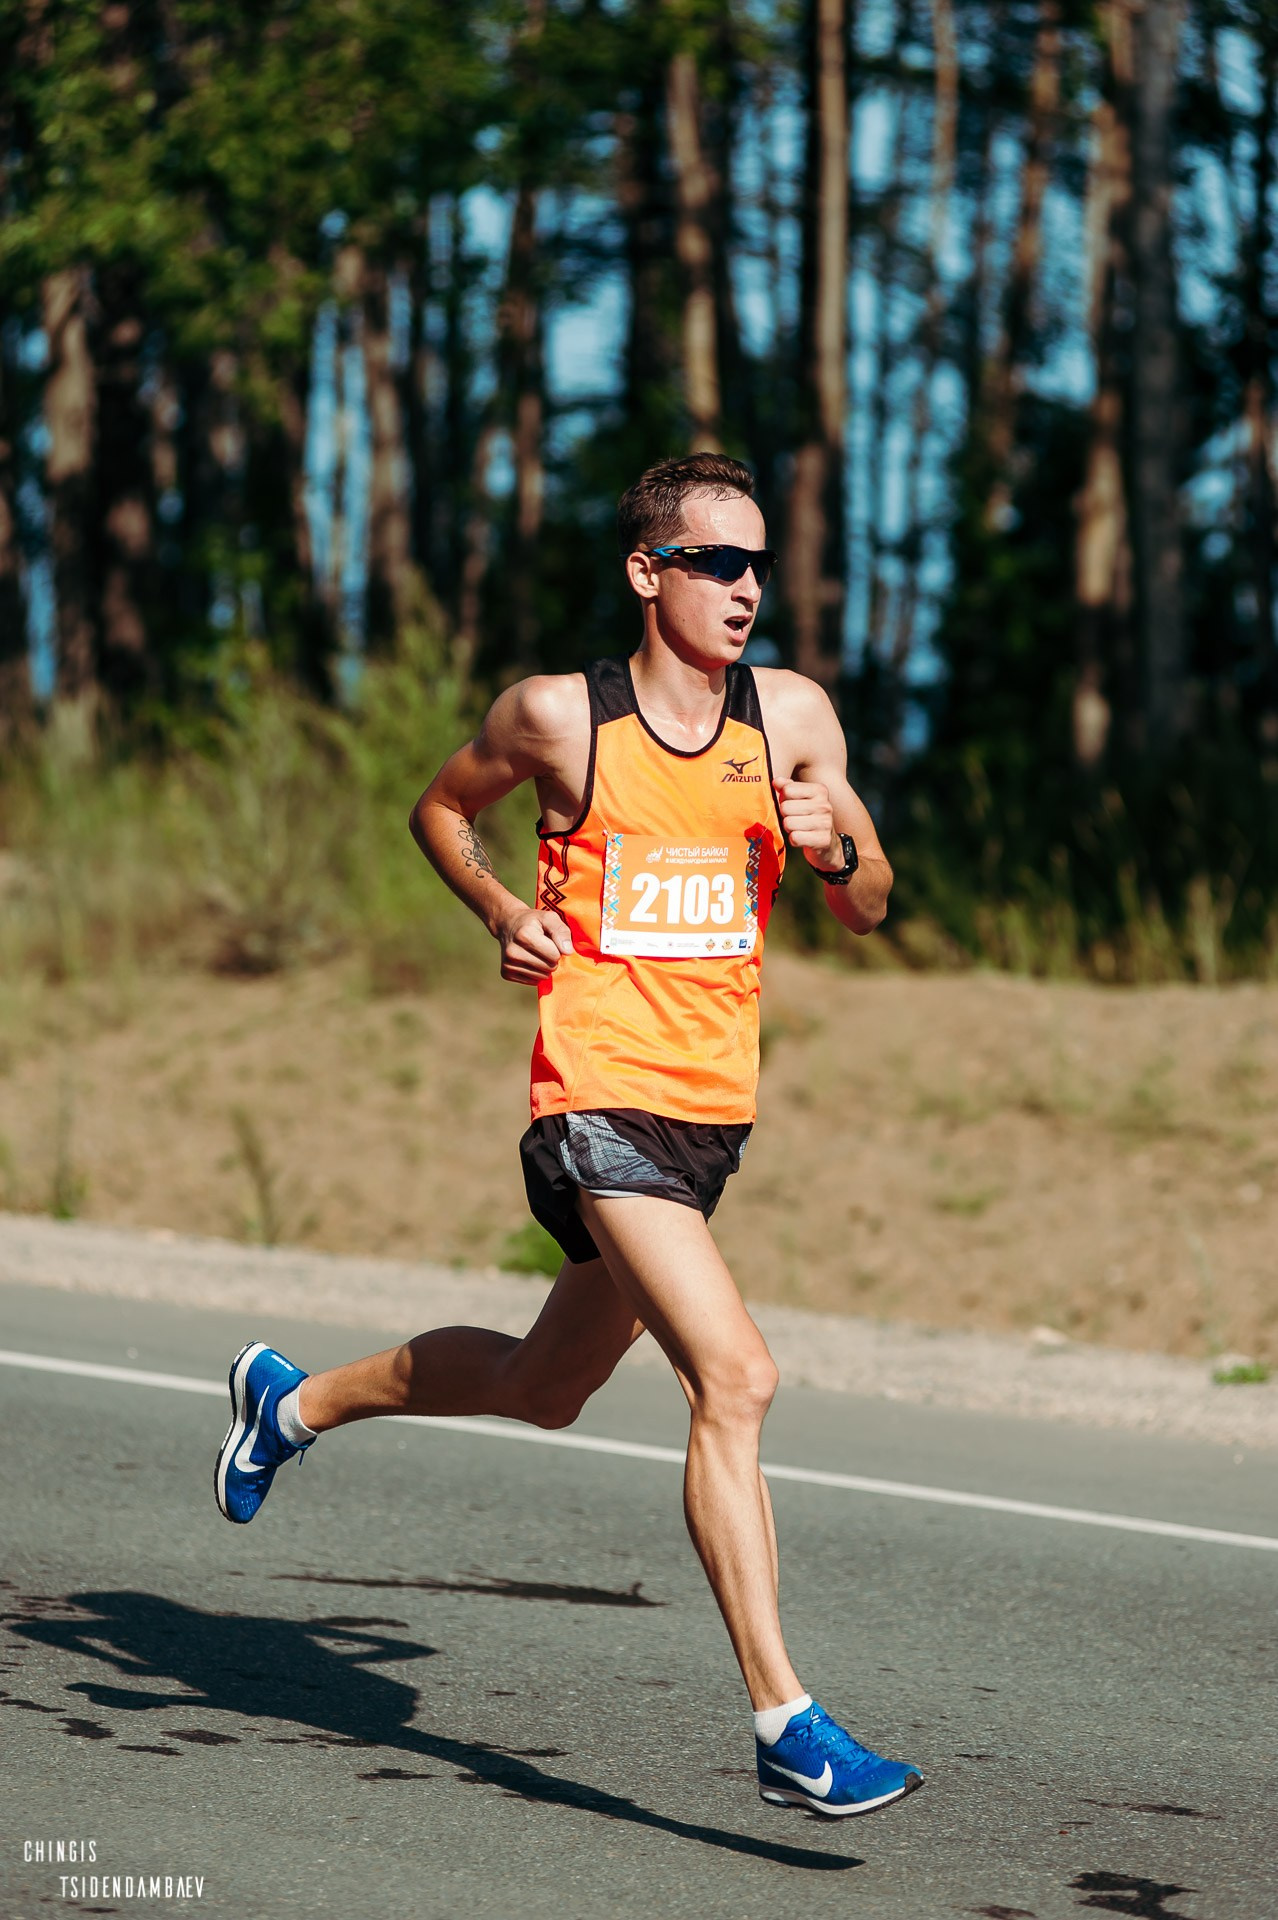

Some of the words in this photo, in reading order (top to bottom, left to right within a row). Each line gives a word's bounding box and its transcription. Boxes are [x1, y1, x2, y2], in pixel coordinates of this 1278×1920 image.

[665, 846, 700, 857] ЧИСТЫЙ
[701, 846, 728, 857] БАЙКАЛ
[629, 872, 735, 925] 2103
